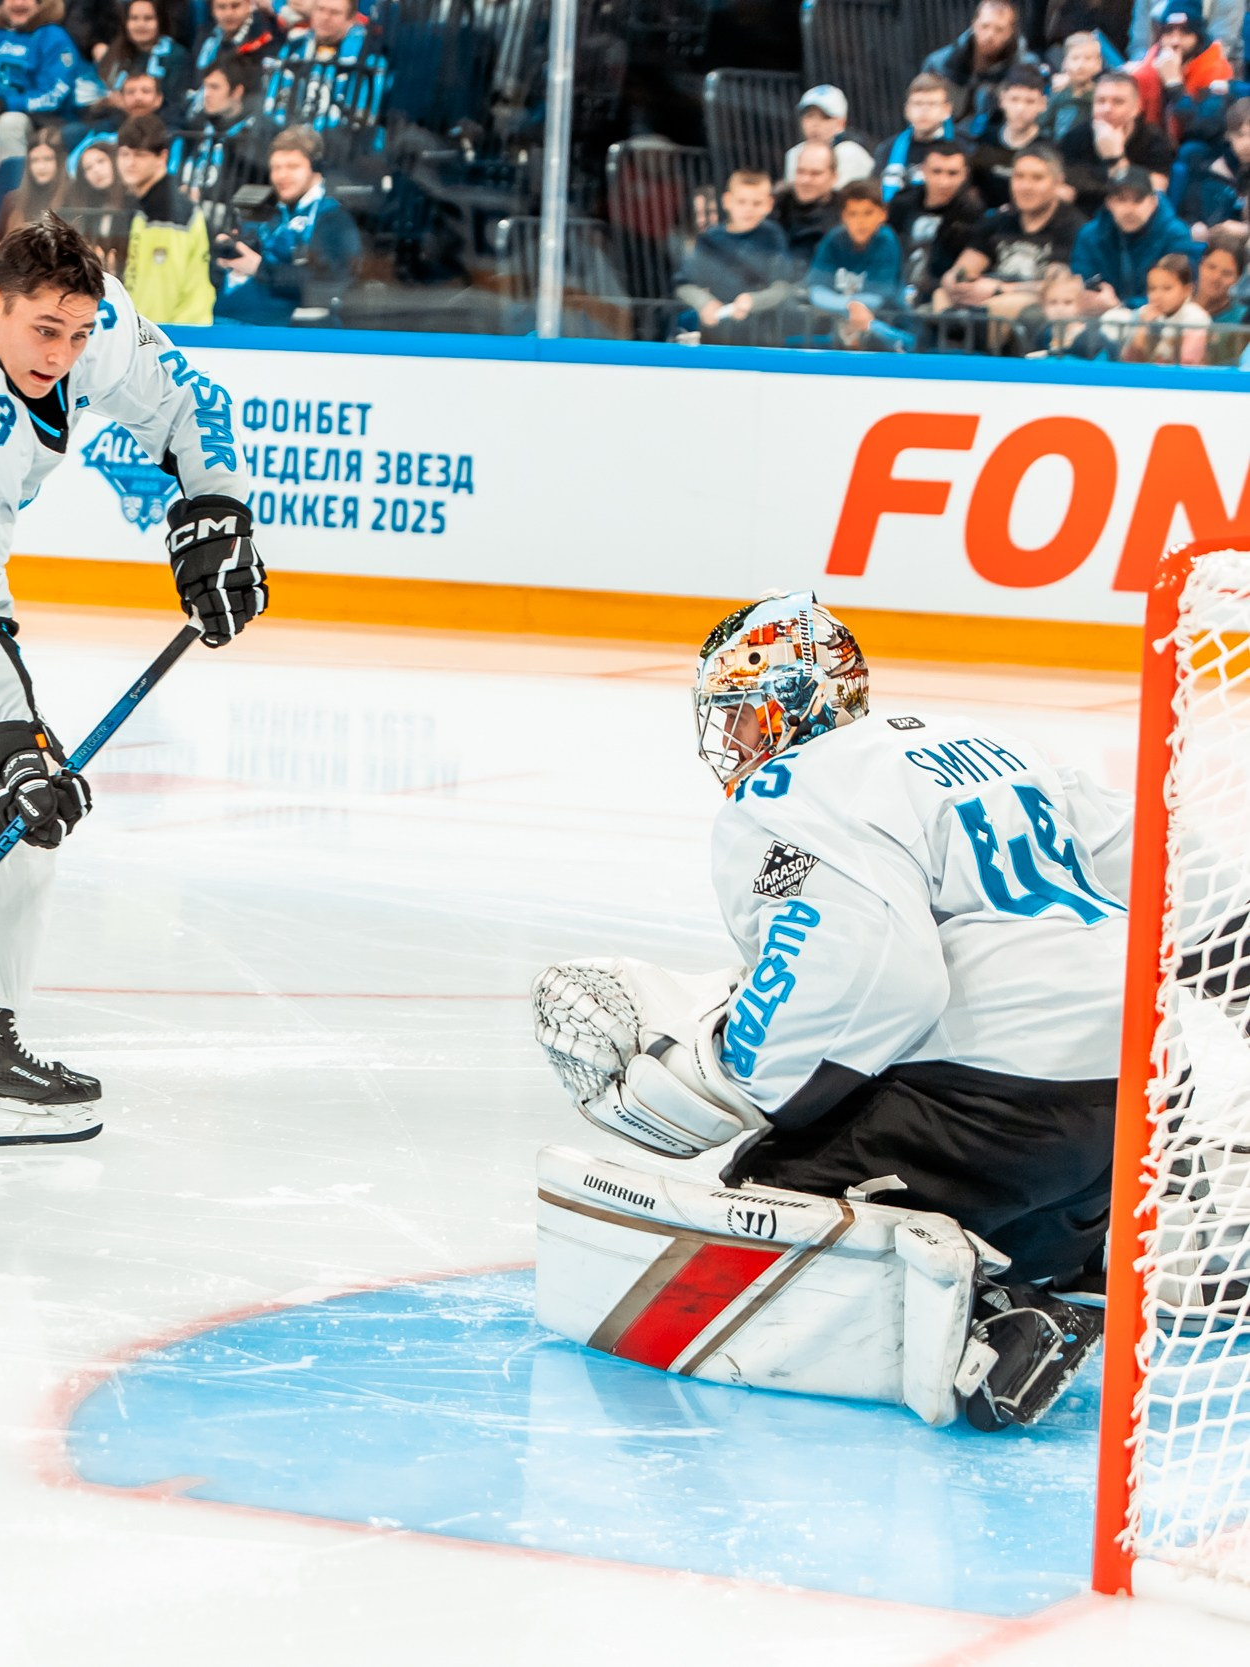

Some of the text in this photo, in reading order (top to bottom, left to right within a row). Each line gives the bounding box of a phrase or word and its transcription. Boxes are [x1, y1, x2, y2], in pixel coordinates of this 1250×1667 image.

[242, 396, 373, 436] ФОНБЕТ
[243, 445, 475, 495] НЕДЕЛЯ ЗВЕЗД
[166, 515, 238, 554] CM
[370, 498, 447, 535] 2025
[799, 609, 816, 677] WARRIOR
[904, 736, 1029, 789] SMITH
[17, 794, 40, 817] CCM
[754, 854, 814, 893] TARASOV
[770, 869, 806, 896] DIVISION
[9, 1065, 51, 1088] BAUER
[582, 1173, 657, 1211] WARRIOR
